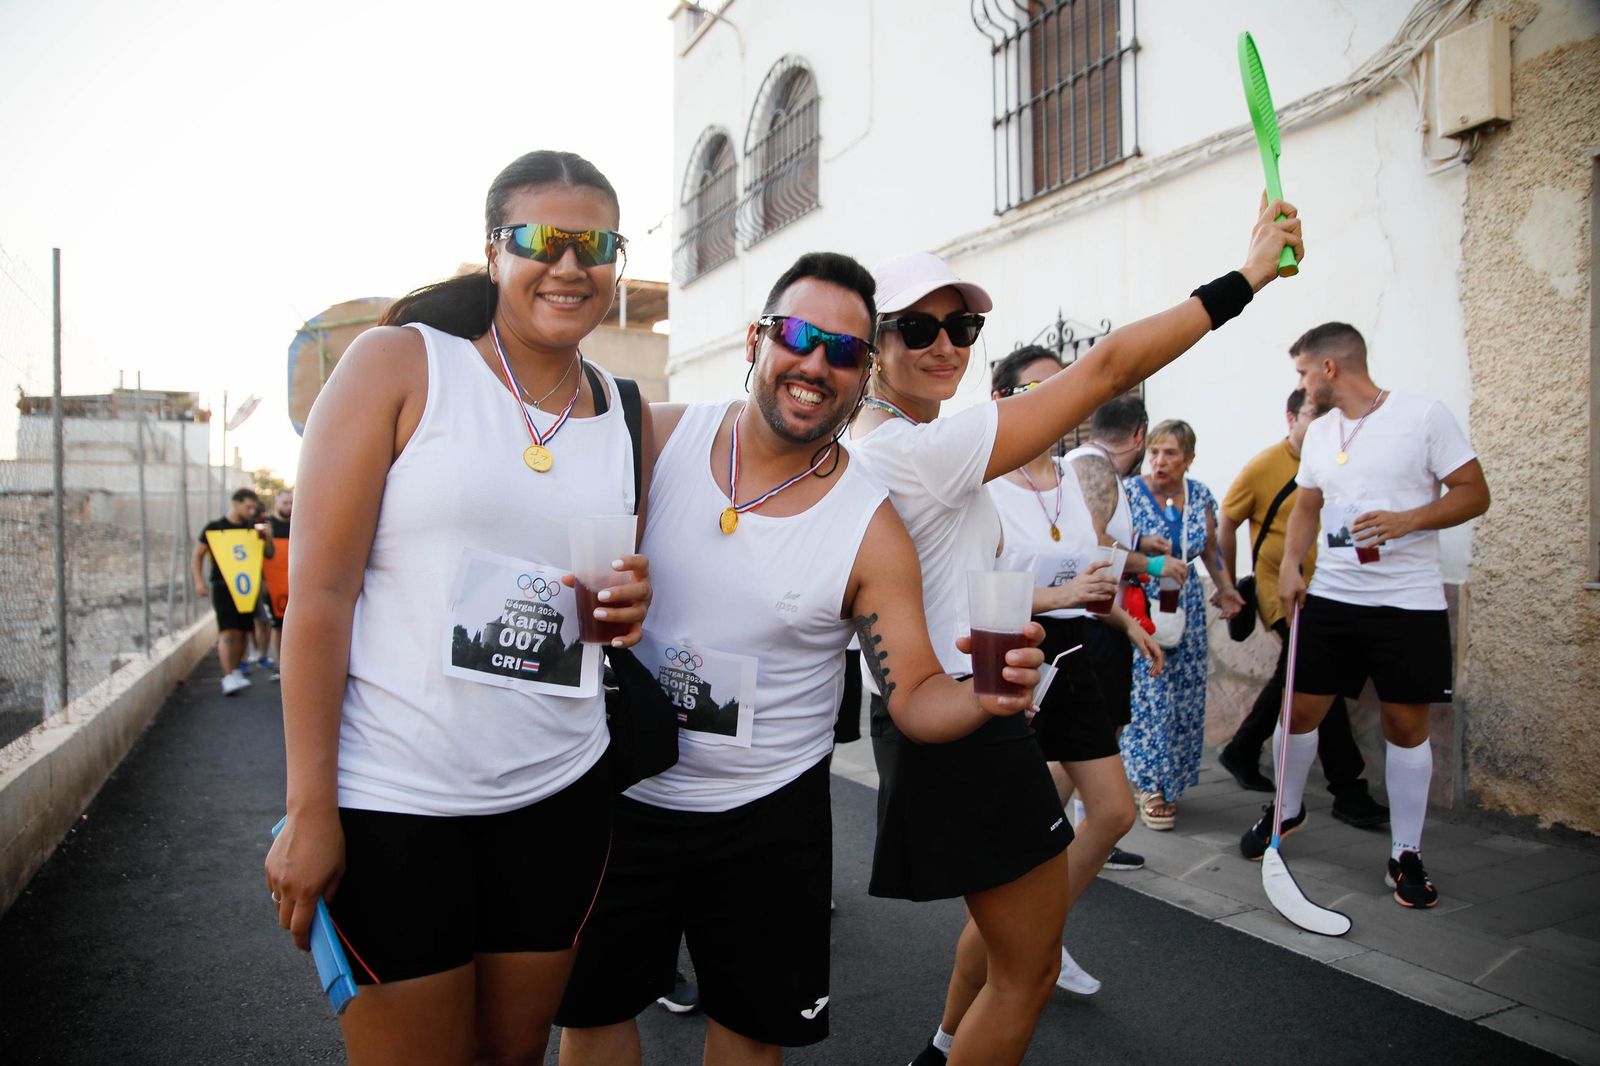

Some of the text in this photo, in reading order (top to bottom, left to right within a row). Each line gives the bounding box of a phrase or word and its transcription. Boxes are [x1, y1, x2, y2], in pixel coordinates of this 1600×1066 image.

[537, 606, 558, 617] 2024
[500, 609, 558, 635] Karen
[498, 627, 547, 653] 007
[491, 653, 522, 671] CRI
[659, 673, 699, 696] Borja
[685, 674, 704, 685] 2024
